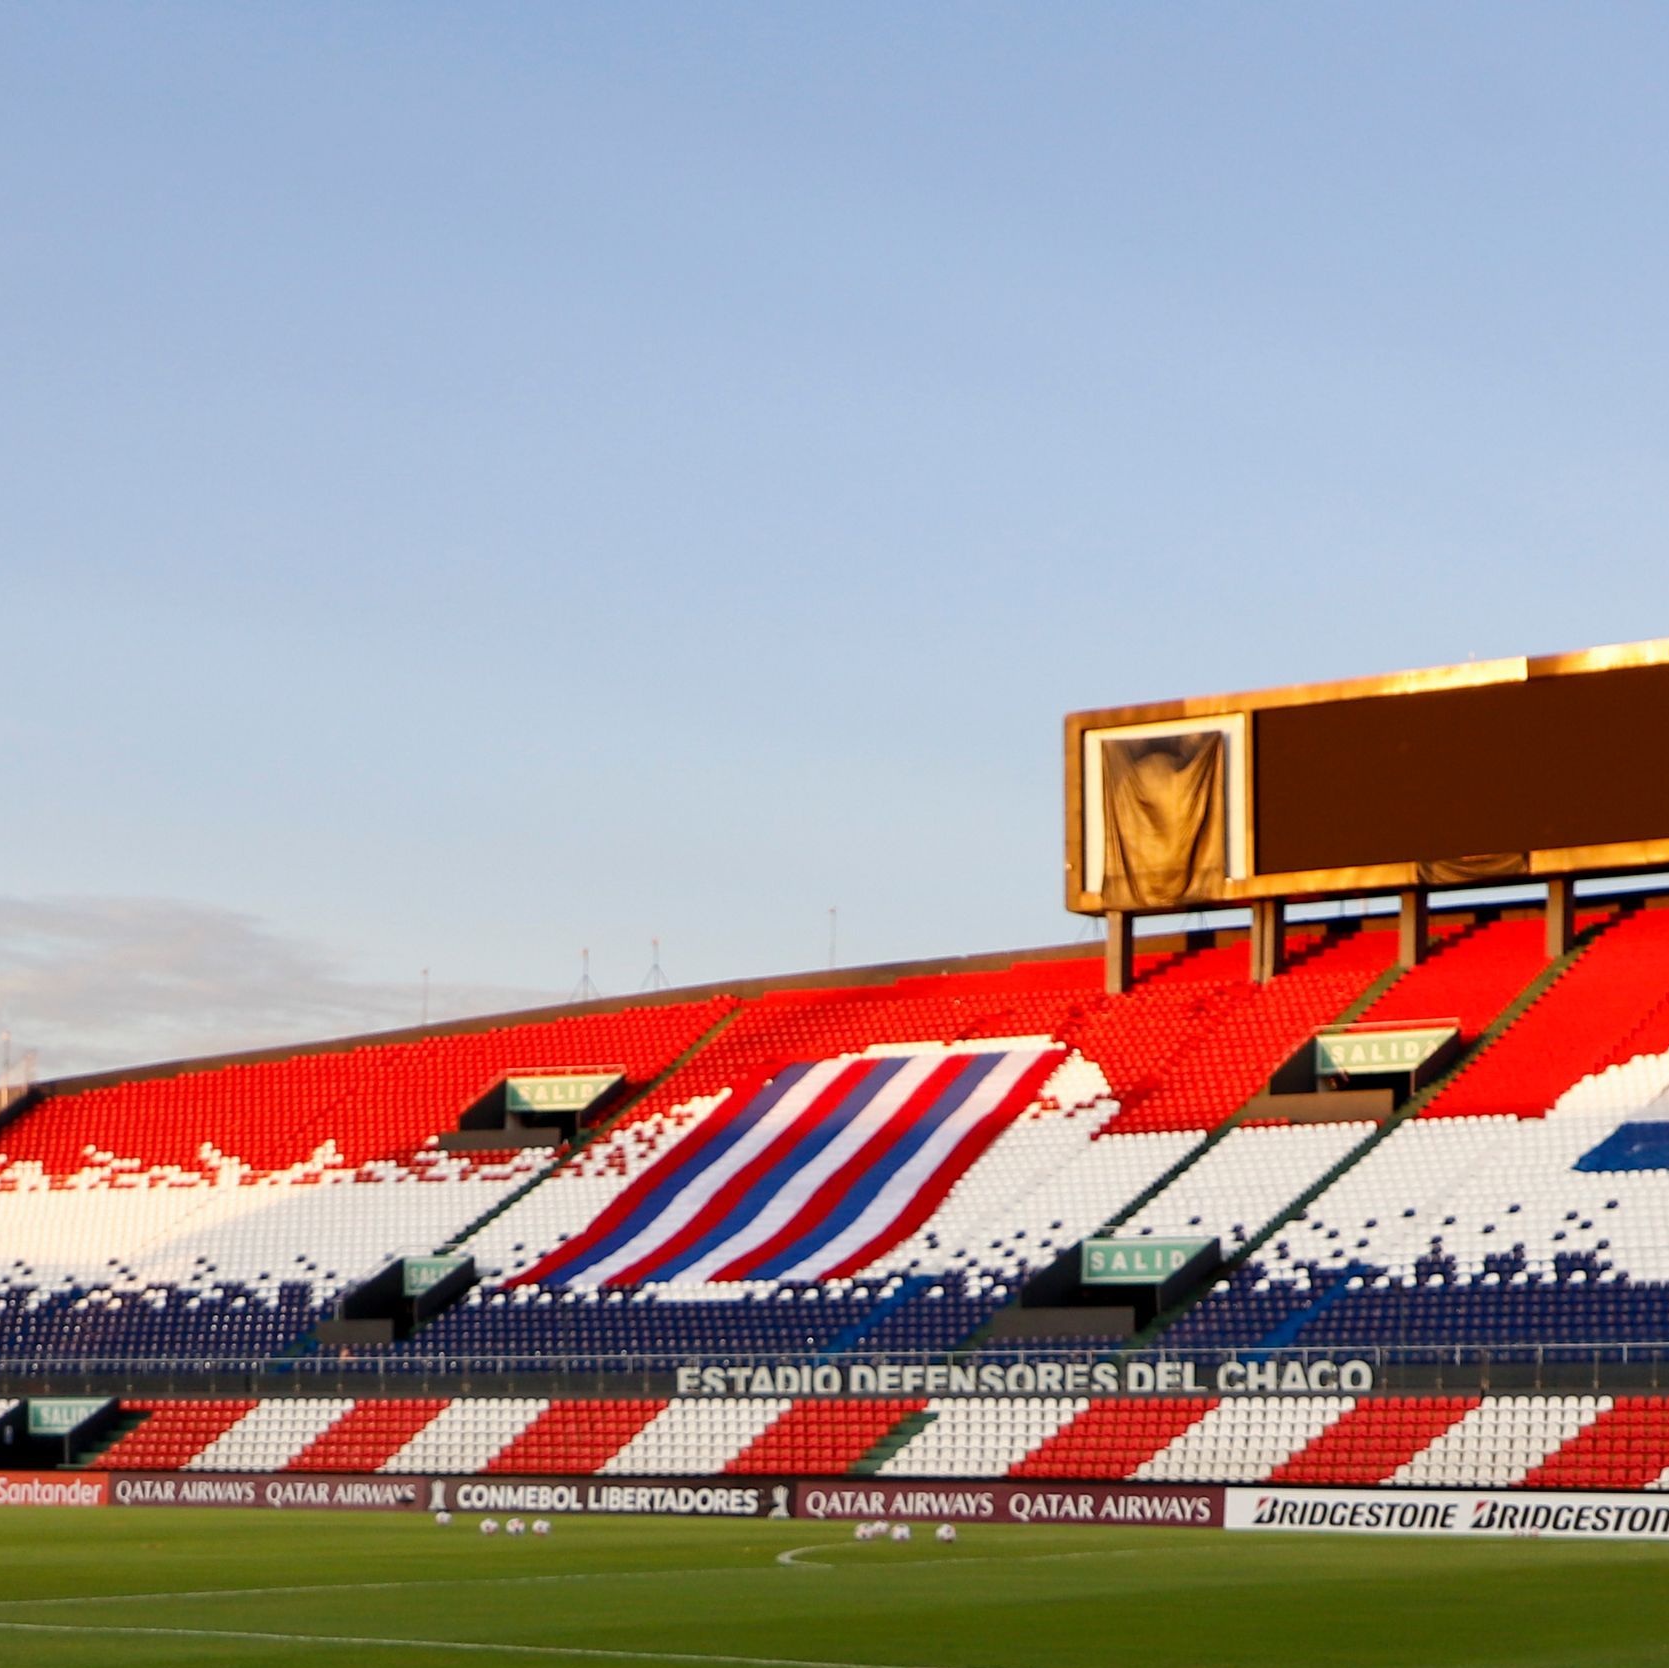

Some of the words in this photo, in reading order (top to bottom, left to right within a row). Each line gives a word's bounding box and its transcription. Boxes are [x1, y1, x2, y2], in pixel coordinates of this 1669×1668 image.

[1090, 1249, 1187, 1272] SALID
[677, 1364, 842, 1395] ESTADIO
[849, 1362, 1119, 1394] DEFENSORES
[1127, 1360, 1209, 1393] DEL
[1217, 1359, 1373, 1393] CHACO
[116, 1480, 175, 1505] QATAR
[179, 1481, 255, 1503] AIRWAYS
[266, 1482, 329, 1507] QATAR
[333, 1483, 416, 1507] AIRWAYS
[457, 1484, 582, 1510] CONMEBOL
[587, 1485, 758, 1513] LIBERTADORES
[805, 1490, 885, 1517] QATAR
[890, 1491, 994, 1517] AIRWAYS
[1008, 1493, 1094, 1520] QATAR
[1100, 1494, 1211, 1523] AIRWAYS
[1252, 1497, 1458, 1531] BRIDGESTONE
